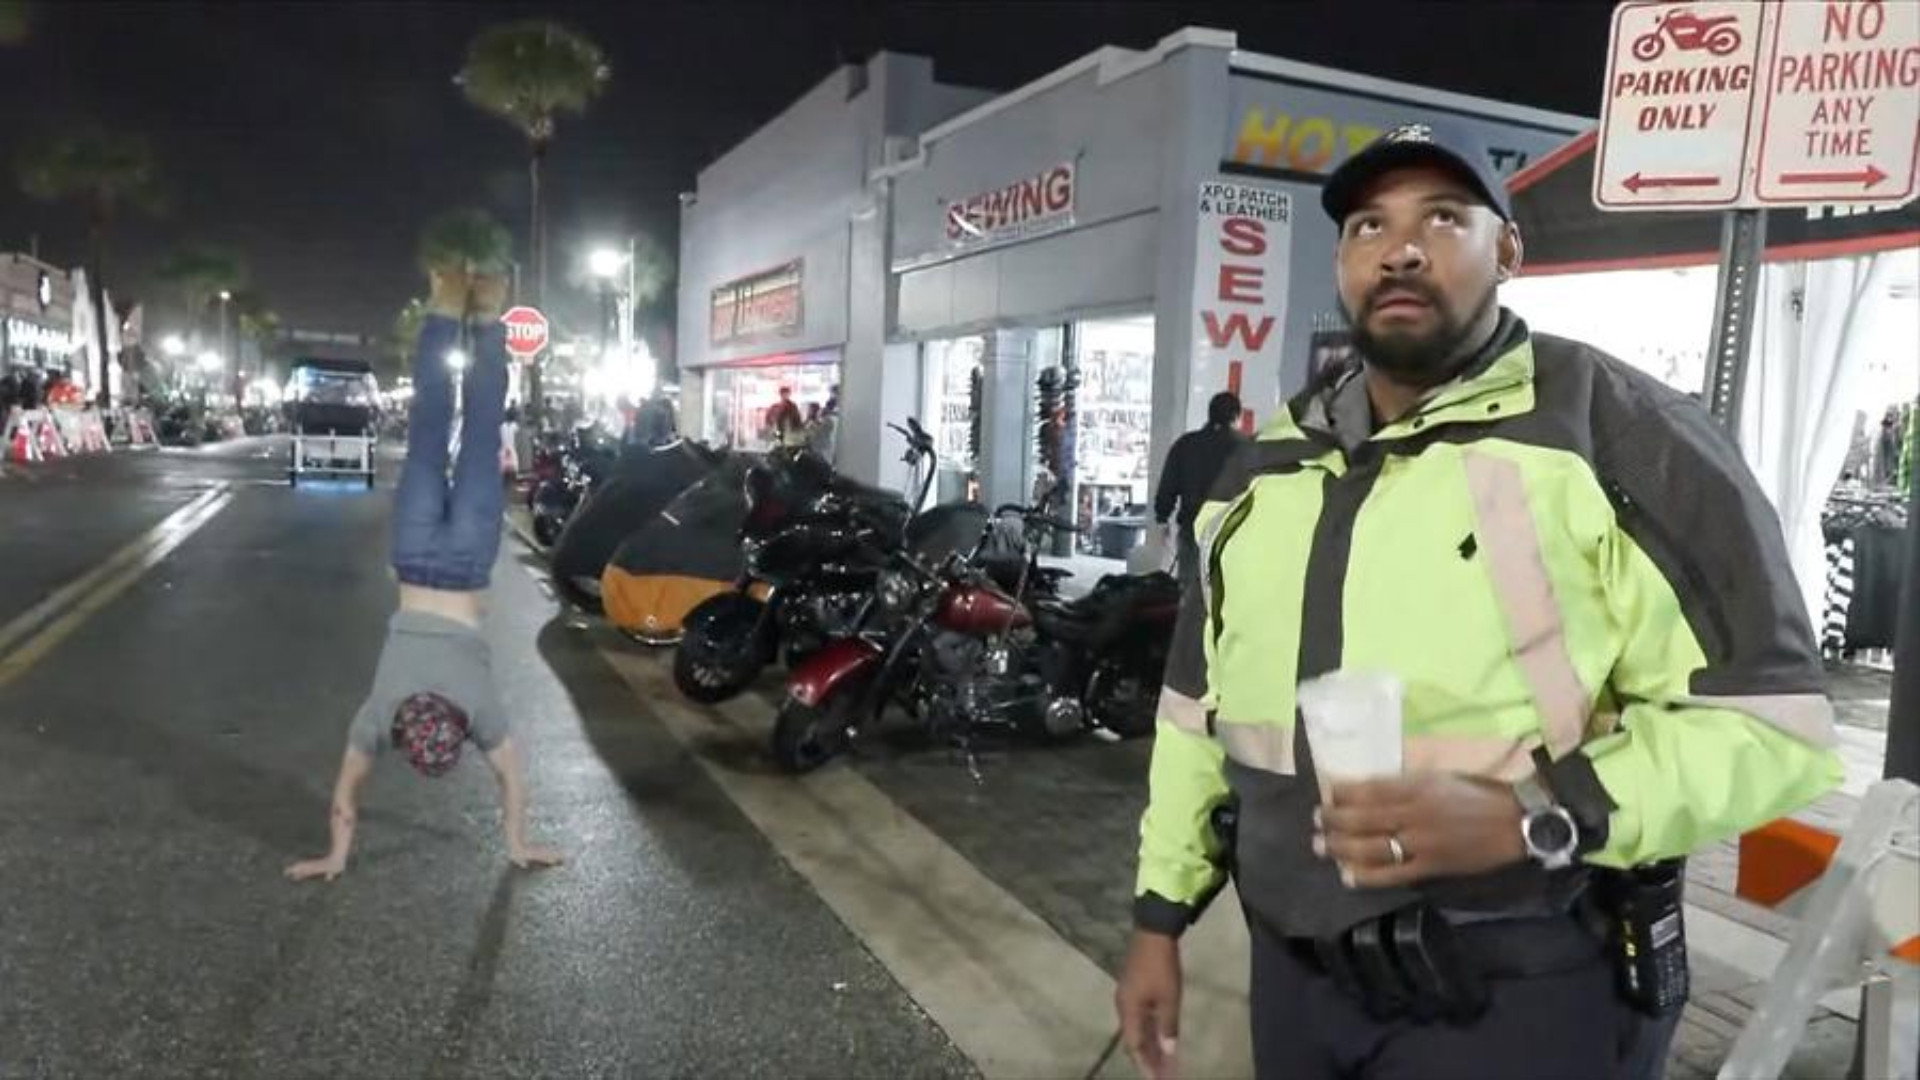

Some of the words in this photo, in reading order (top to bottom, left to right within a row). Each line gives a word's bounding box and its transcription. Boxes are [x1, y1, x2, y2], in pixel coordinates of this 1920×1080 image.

[1823, 1, 1884, 42] NO
[1615, 65, 1750, 97] PARKING
[1777, 47, 1920, 94] PARKING
[1637, 103, 1716, 131] ONLY
[1811, 96, 1874, 124] ANY
[1805, 128, 1872, 158] TIME
[947, 167, 1070, 239] SEWING
[1239, 187, 1287, 206] PATCH
[1216, 201, 1288, 223] LEATHER
[505, 321, 544, 343] STOP
